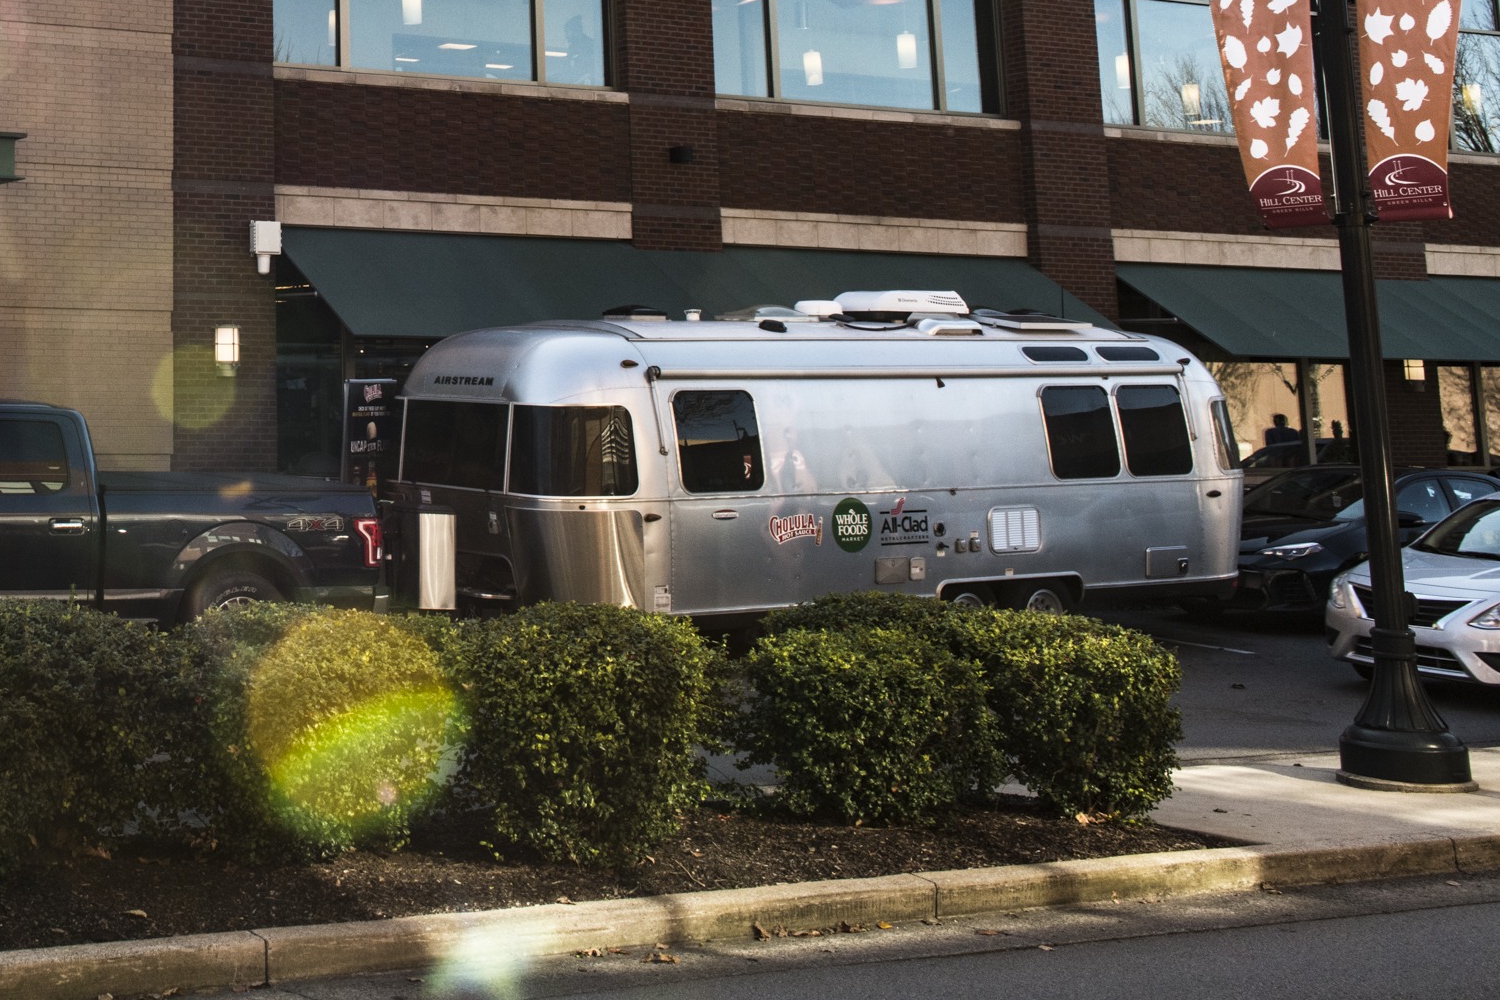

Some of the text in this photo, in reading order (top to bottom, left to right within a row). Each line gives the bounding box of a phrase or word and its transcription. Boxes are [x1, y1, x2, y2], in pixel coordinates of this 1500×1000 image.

[1373, 184, 1443, 199] HILL CENTER
[1259, 194, 1322, 208] HILL CENTER
[434, 375, 495, 386] AIRSTREAM
[835, 509, 869, 525] WHOLE
[769, 513, 816, 541] CHOLULA
[838, 524, 868, 536] FOODS
[881, 515, 929, 534] All-Clad
[781, 528, 813, 541] HOT SAUCE
